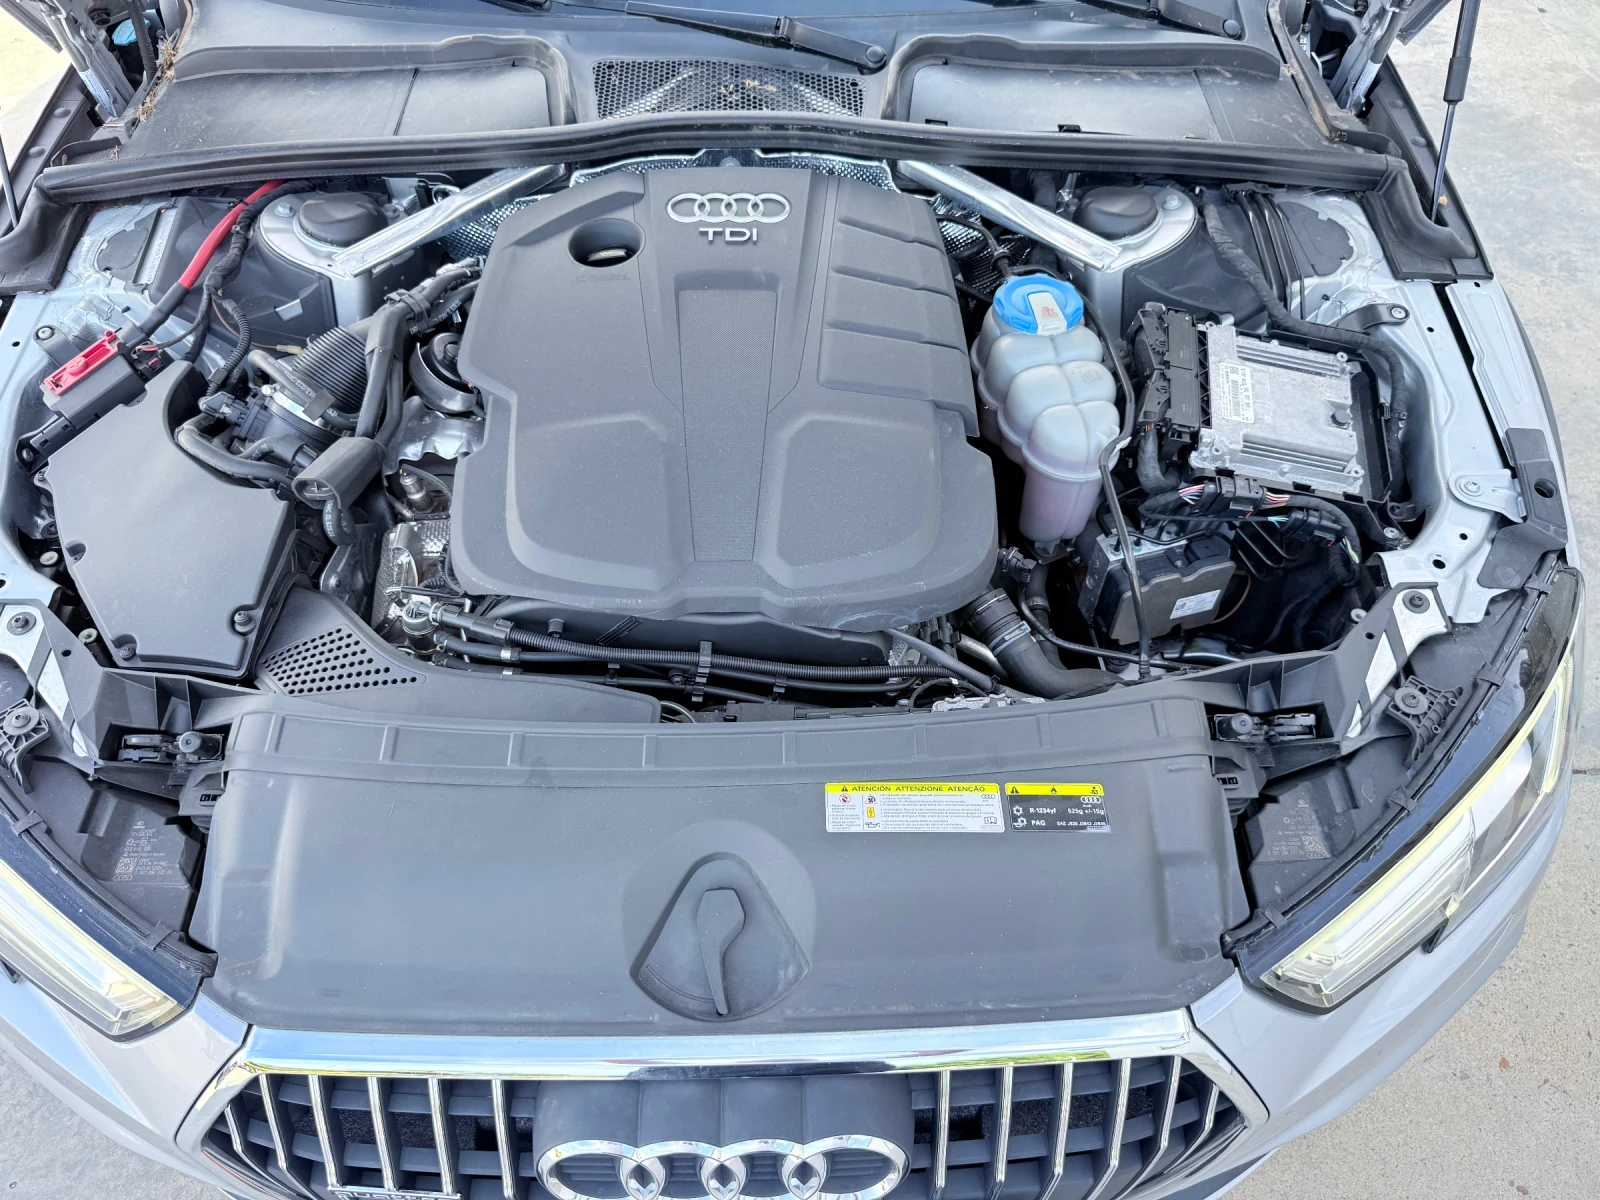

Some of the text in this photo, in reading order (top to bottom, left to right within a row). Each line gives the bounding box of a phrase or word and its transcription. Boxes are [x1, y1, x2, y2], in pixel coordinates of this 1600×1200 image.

[698, 227, 758, 242] TDI
[851, 784, 891, 792] ATENCIÓN
[947, 785, 986, 793] ATENÇÃO
[1029, 807, 1057, 815] R-1234yf
